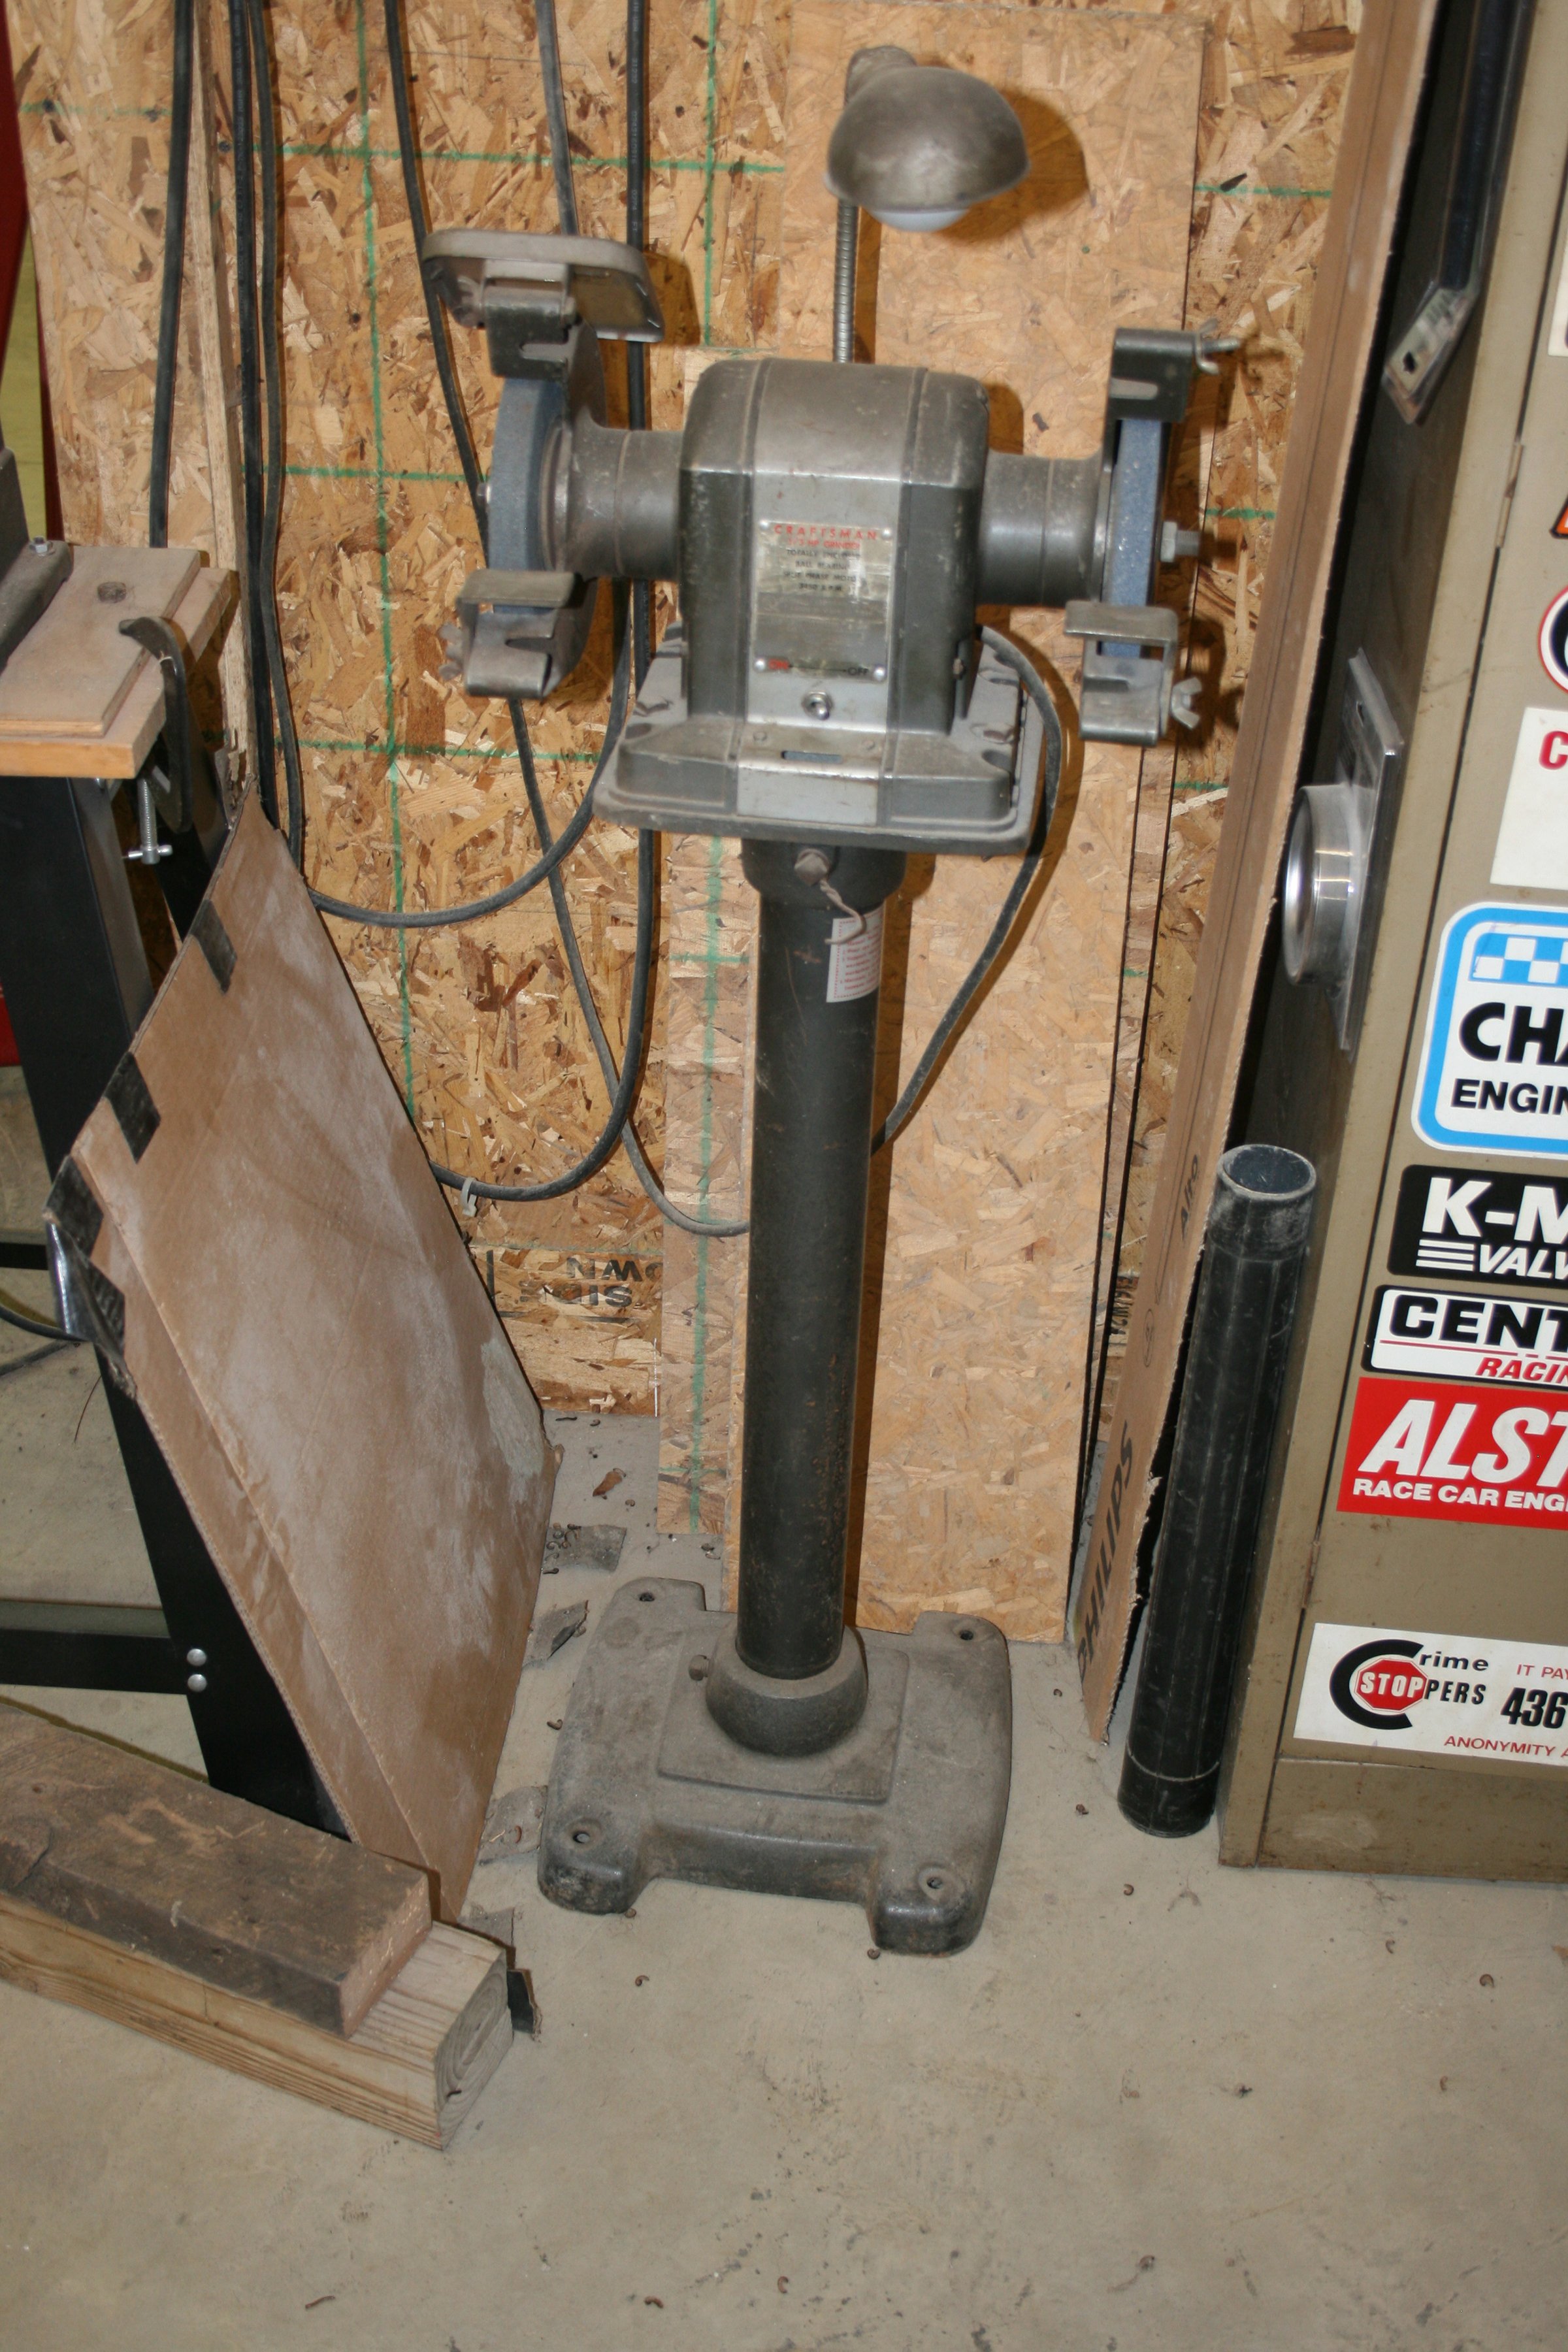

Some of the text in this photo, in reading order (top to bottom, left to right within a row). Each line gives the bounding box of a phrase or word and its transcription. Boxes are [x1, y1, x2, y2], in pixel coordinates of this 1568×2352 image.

[774, 524, 877, 540] CRAFTSMAN
[768, 658, 869, 676] ON OFF
[1539, 730, 1568, 770] C
[1458, 1002, 1568, 1068] CH
[1422, 1177, 1568, 1245] K-M
[1389, 1294, 1568, 1353] CENT
[1357, 1399, 1568, 1488] ALST
[1352, 1478, 1568, 1512] RACE CAR ENG
[1077, 1420, 1132, 1686] PHILIPS
[1516, 1663, 1535, 1676] IT
[1500, 1686, 1568, 1729] 436
[1443, 1735, 1556, 1757] ANONYMITY
